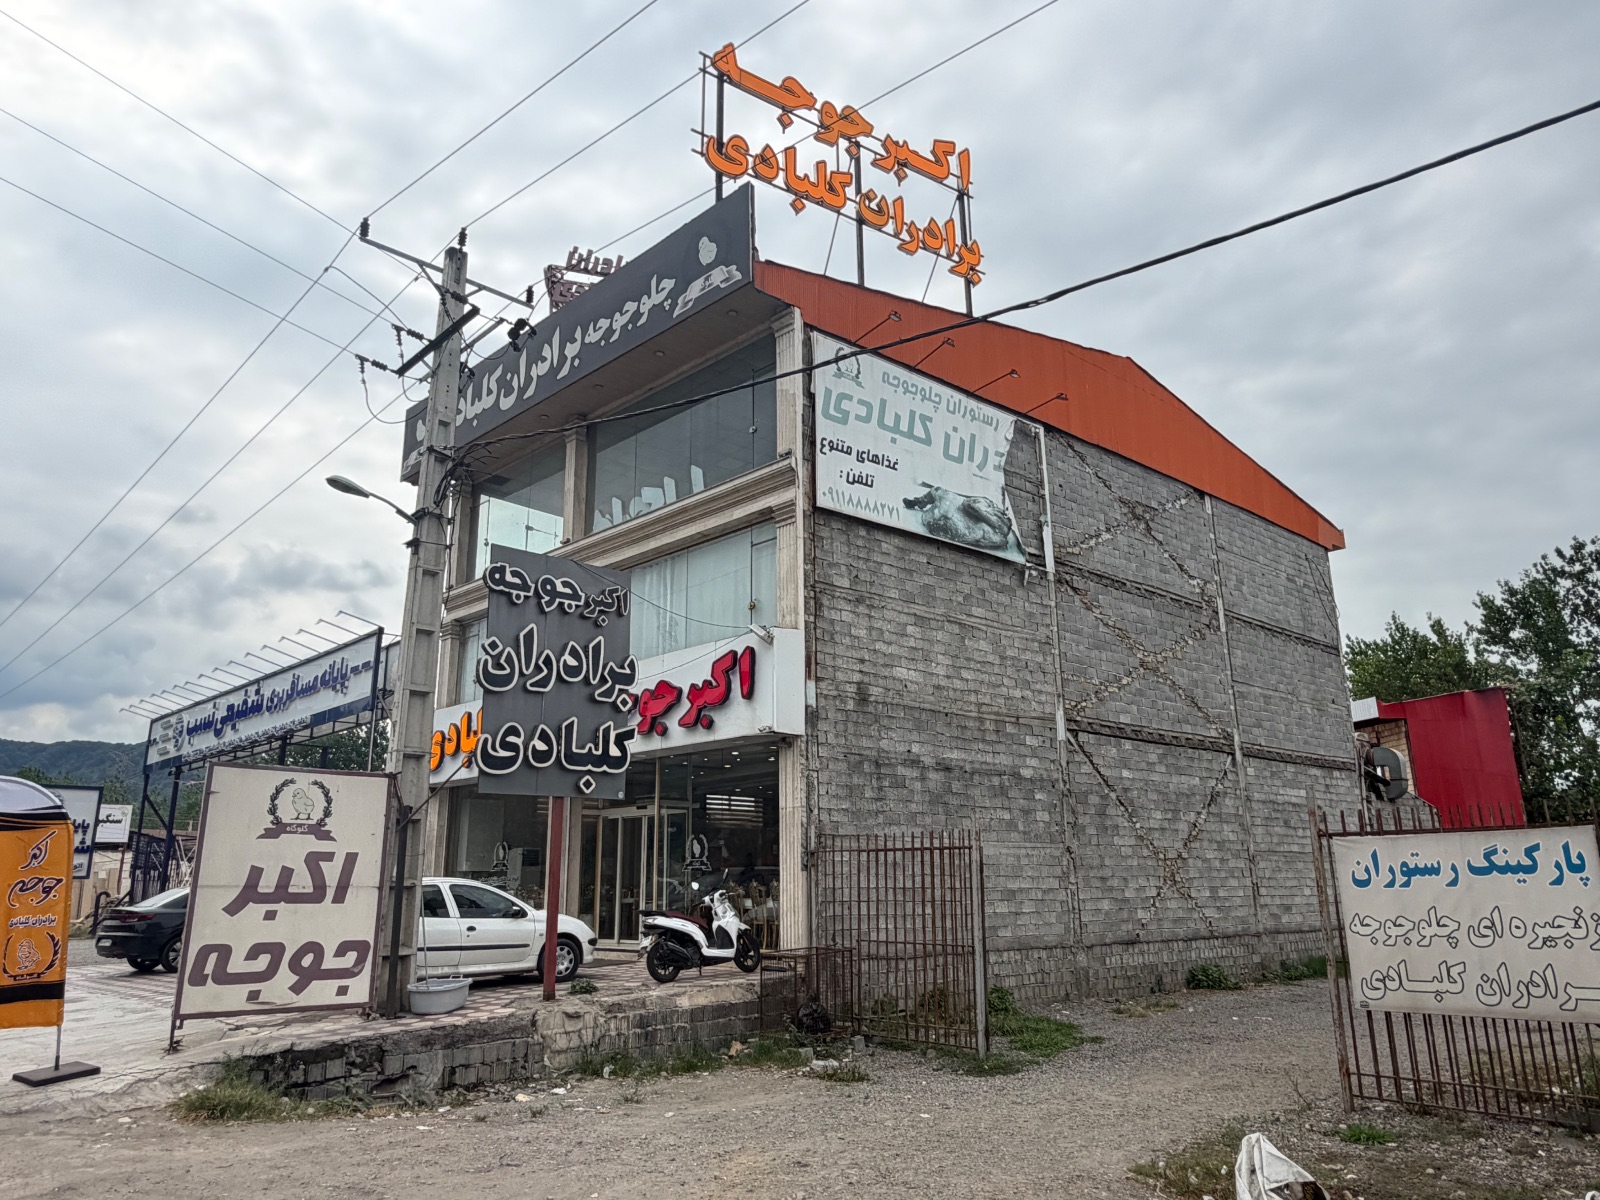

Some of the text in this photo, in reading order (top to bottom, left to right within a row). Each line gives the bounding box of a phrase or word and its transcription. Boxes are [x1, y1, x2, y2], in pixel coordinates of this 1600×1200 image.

[870, 134, 973, 193] اکبر
[704, 134, 985, 287] برادران کلبادی
[456, 364, 503, 428] کلباد
[500, 325, 583, 411] برادران
[821, 385, 934, 447] کلبادی
[945, 393, 1000, 433] رستوران
[819, 436, 899, 472] غذاهای متنوع
[580, 583, 631, 627] اکبر
[477, 623, 640, 712] برادران
[678, 645, 756, 730] اکبر
[476, 716, 639, 795] کلبادی
[221, 851, 360, 921] اکبر
[1351, 840, 1591, 889] پارکینگ رستوران
[187, 939, 372, 1002] جوجه
[1361, 959, 1600, 1011] رادران کلبادی
